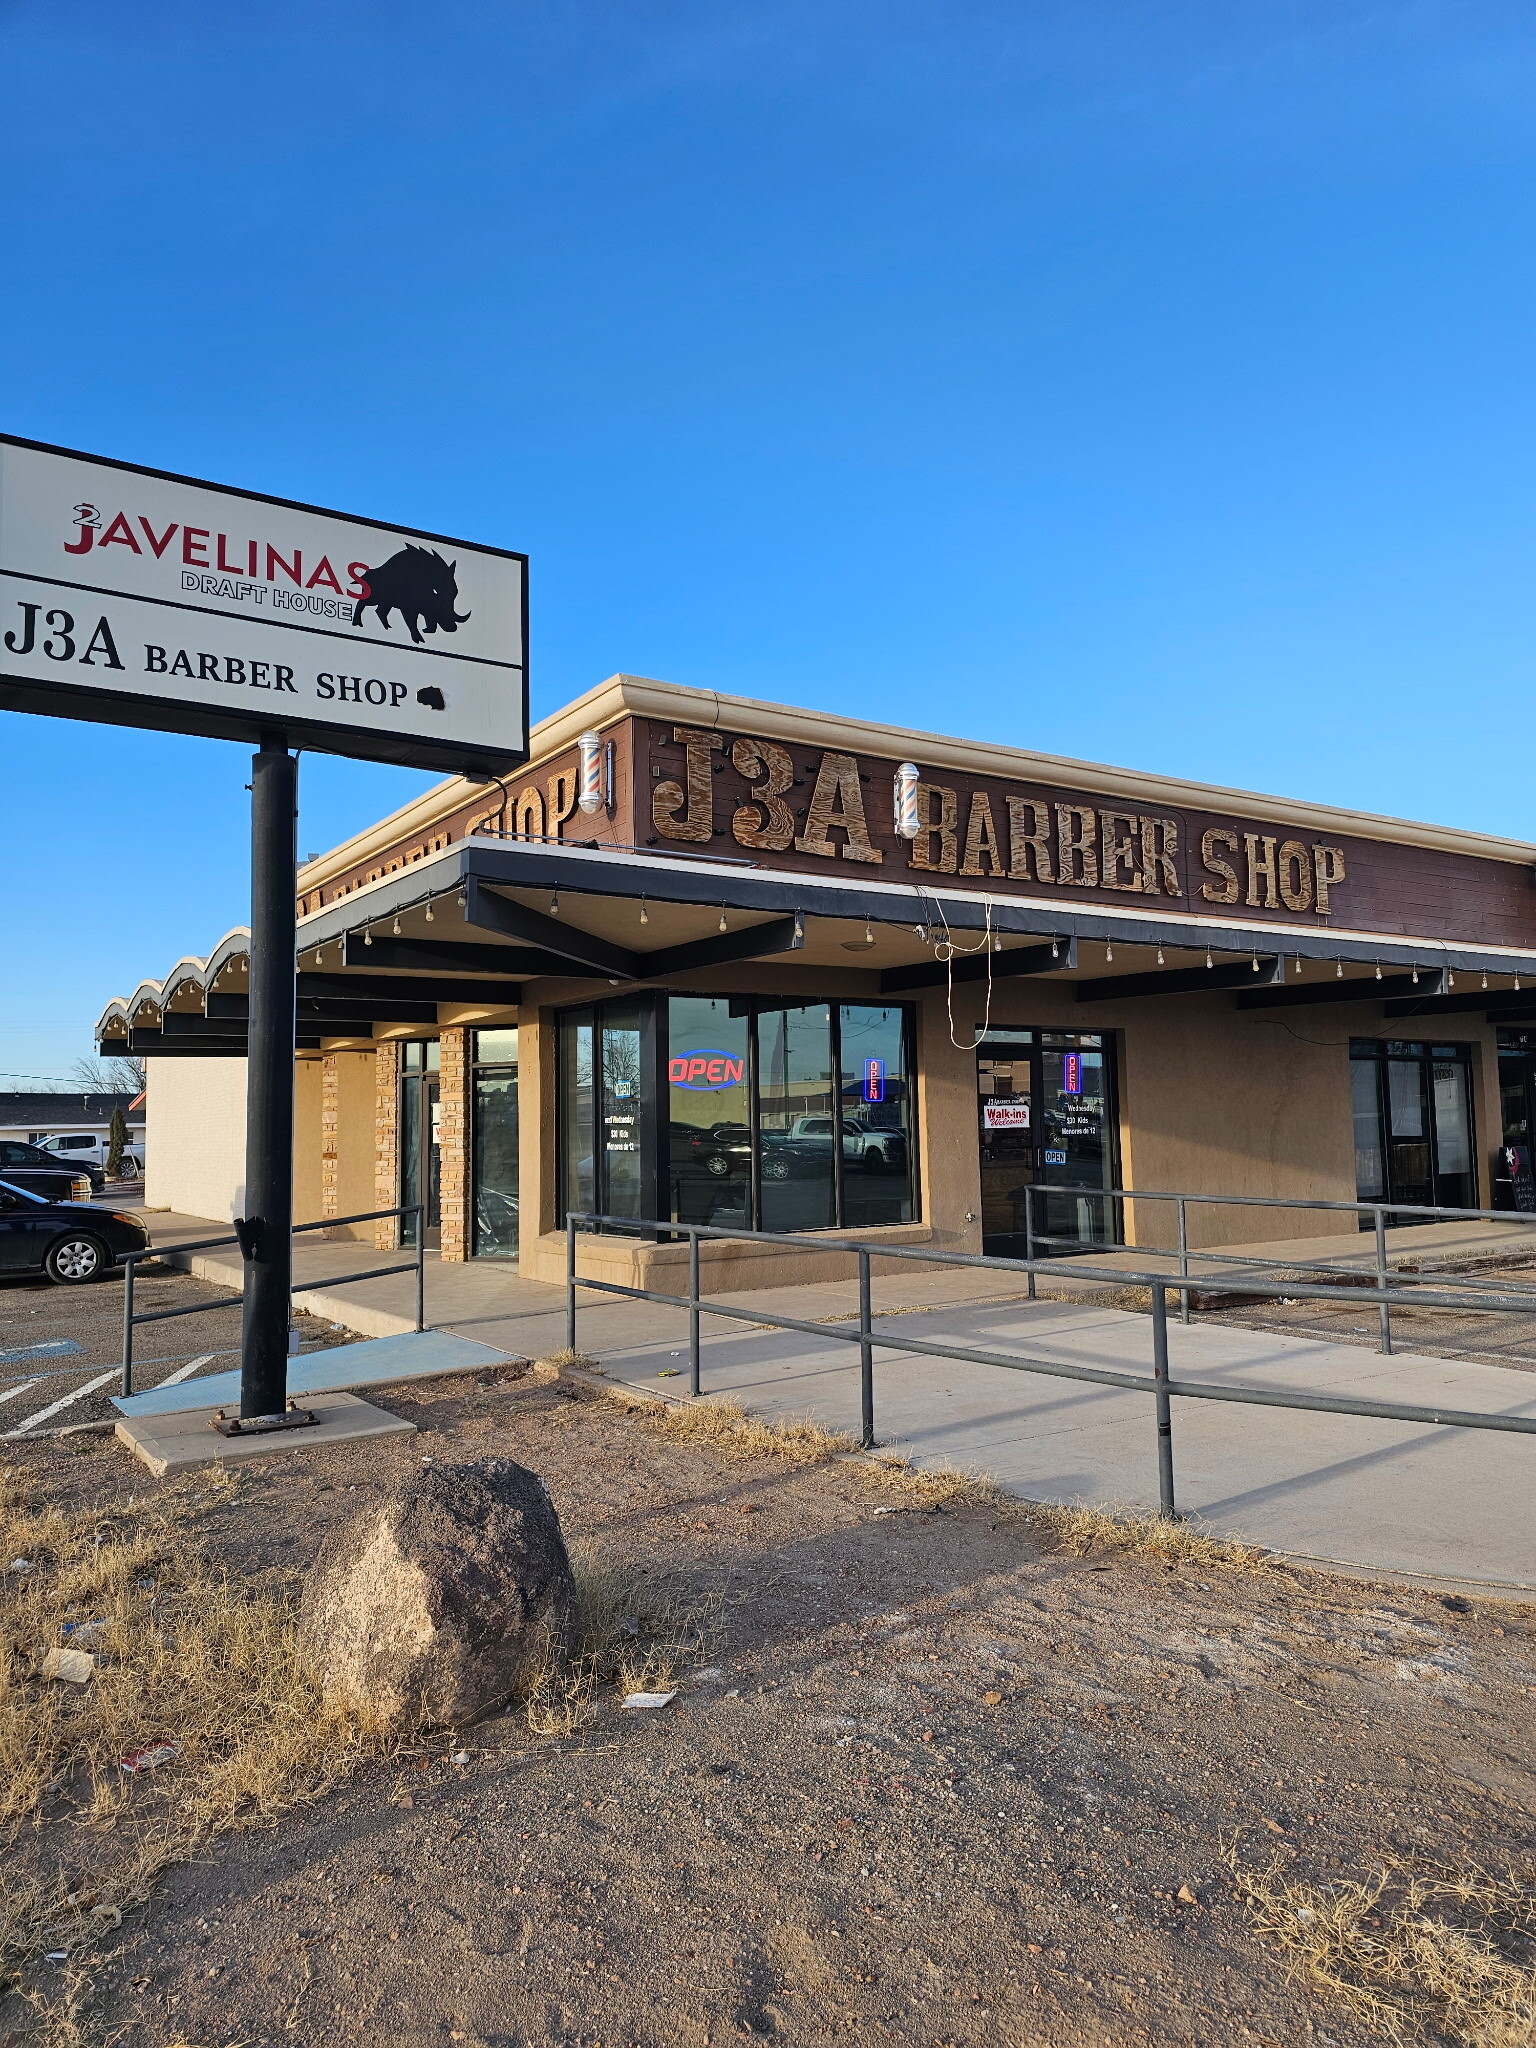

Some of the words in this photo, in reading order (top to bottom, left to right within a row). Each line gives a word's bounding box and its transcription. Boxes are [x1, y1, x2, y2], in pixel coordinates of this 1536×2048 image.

[63, 502, 373, 600] JAVELINAS
[181, 571, 268, 605] DRAFT
[273, 588, 353, 621] HOUSE
[4, 601, 126, 671] J3A
[144, 644, 299, 694] BARBER
[315, 672, 408, 708] SHOP
[652, 726, 884, 864] J3A
[908, 782, 1184, 897] BARBER
[1202, 827, 1347, 915] SHOP
[669, 1058, 744, 1082] OPEN
[870, 1061, 878, 1099] OPEN
[987, 1108, 1027, 1119] Walk-ins
[1068, 1104, 1094, 1114] Wednesday
[1077, 1116, 1089, 1124] Kids
[1061, 1127, 1082, 1135] Menores
[1046, 1151, 1065, 1163] OPEN
